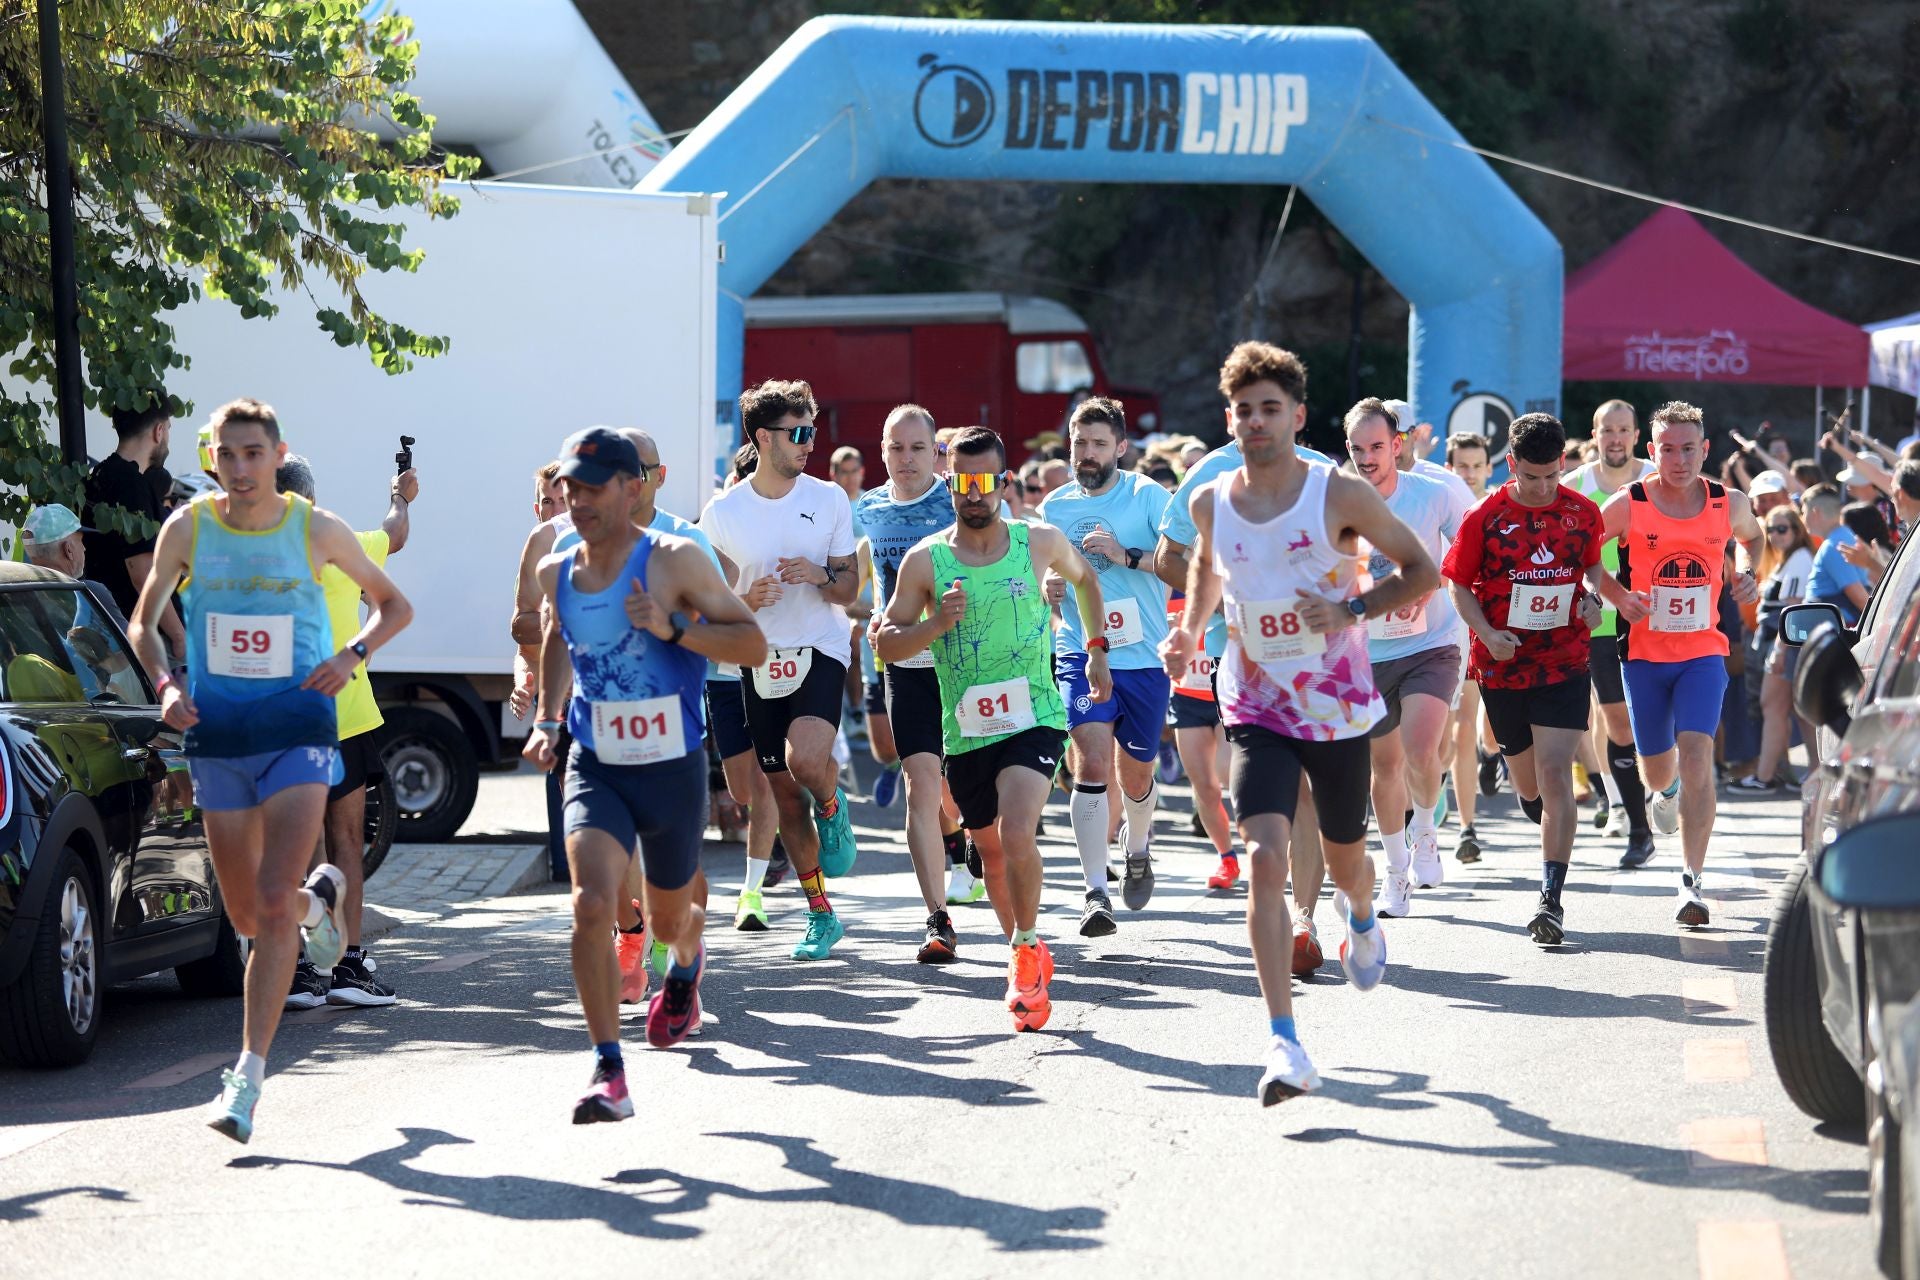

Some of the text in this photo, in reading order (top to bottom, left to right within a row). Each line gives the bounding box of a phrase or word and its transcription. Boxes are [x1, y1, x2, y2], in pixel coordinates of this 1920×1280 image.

[1004, 69, 1308, 155] DEPORCHIP
[586, 117, 639, 187] TOLED
[1508, 566, 1574, 581] Santander
[1529, 595, 1560, 613] 84
[1668, 597, 1696, 616] 51
[1259, 612, 1301, 638] 88
[231, 629, 271, 655] 59
[769, 660, 797, 680] 50
[977, 693, 1010, 717] 81
[609, 711, 667, 740] 101
